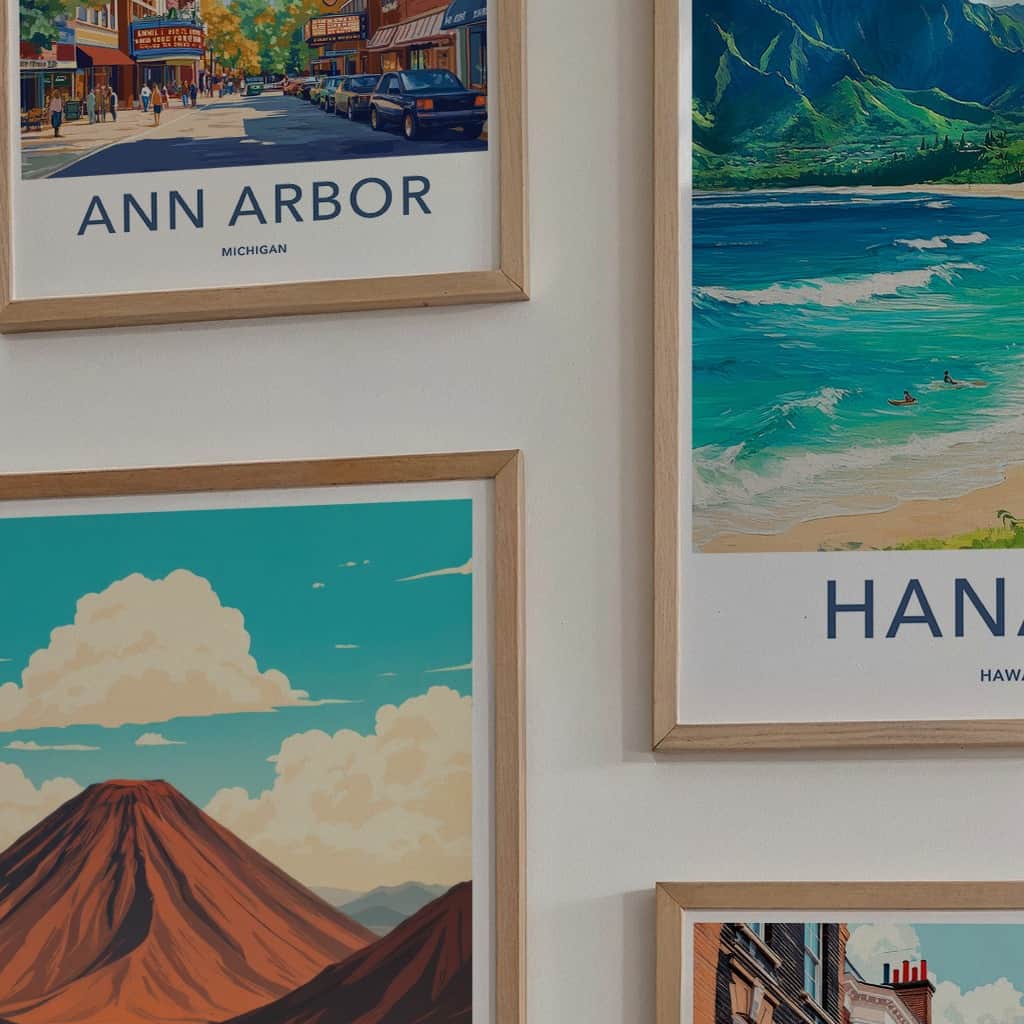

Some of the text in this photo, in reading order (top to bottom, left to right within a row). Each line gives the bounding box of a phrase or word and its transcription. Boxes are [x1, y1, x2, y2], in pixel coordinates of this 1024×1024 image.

[77, 175, 432, 236] ANN ARBOR
[221, 244, 287, 257] MICHIGAN
[826, 577, 1024, 640] HAN
[980, 668, 1024, 682] HAW
